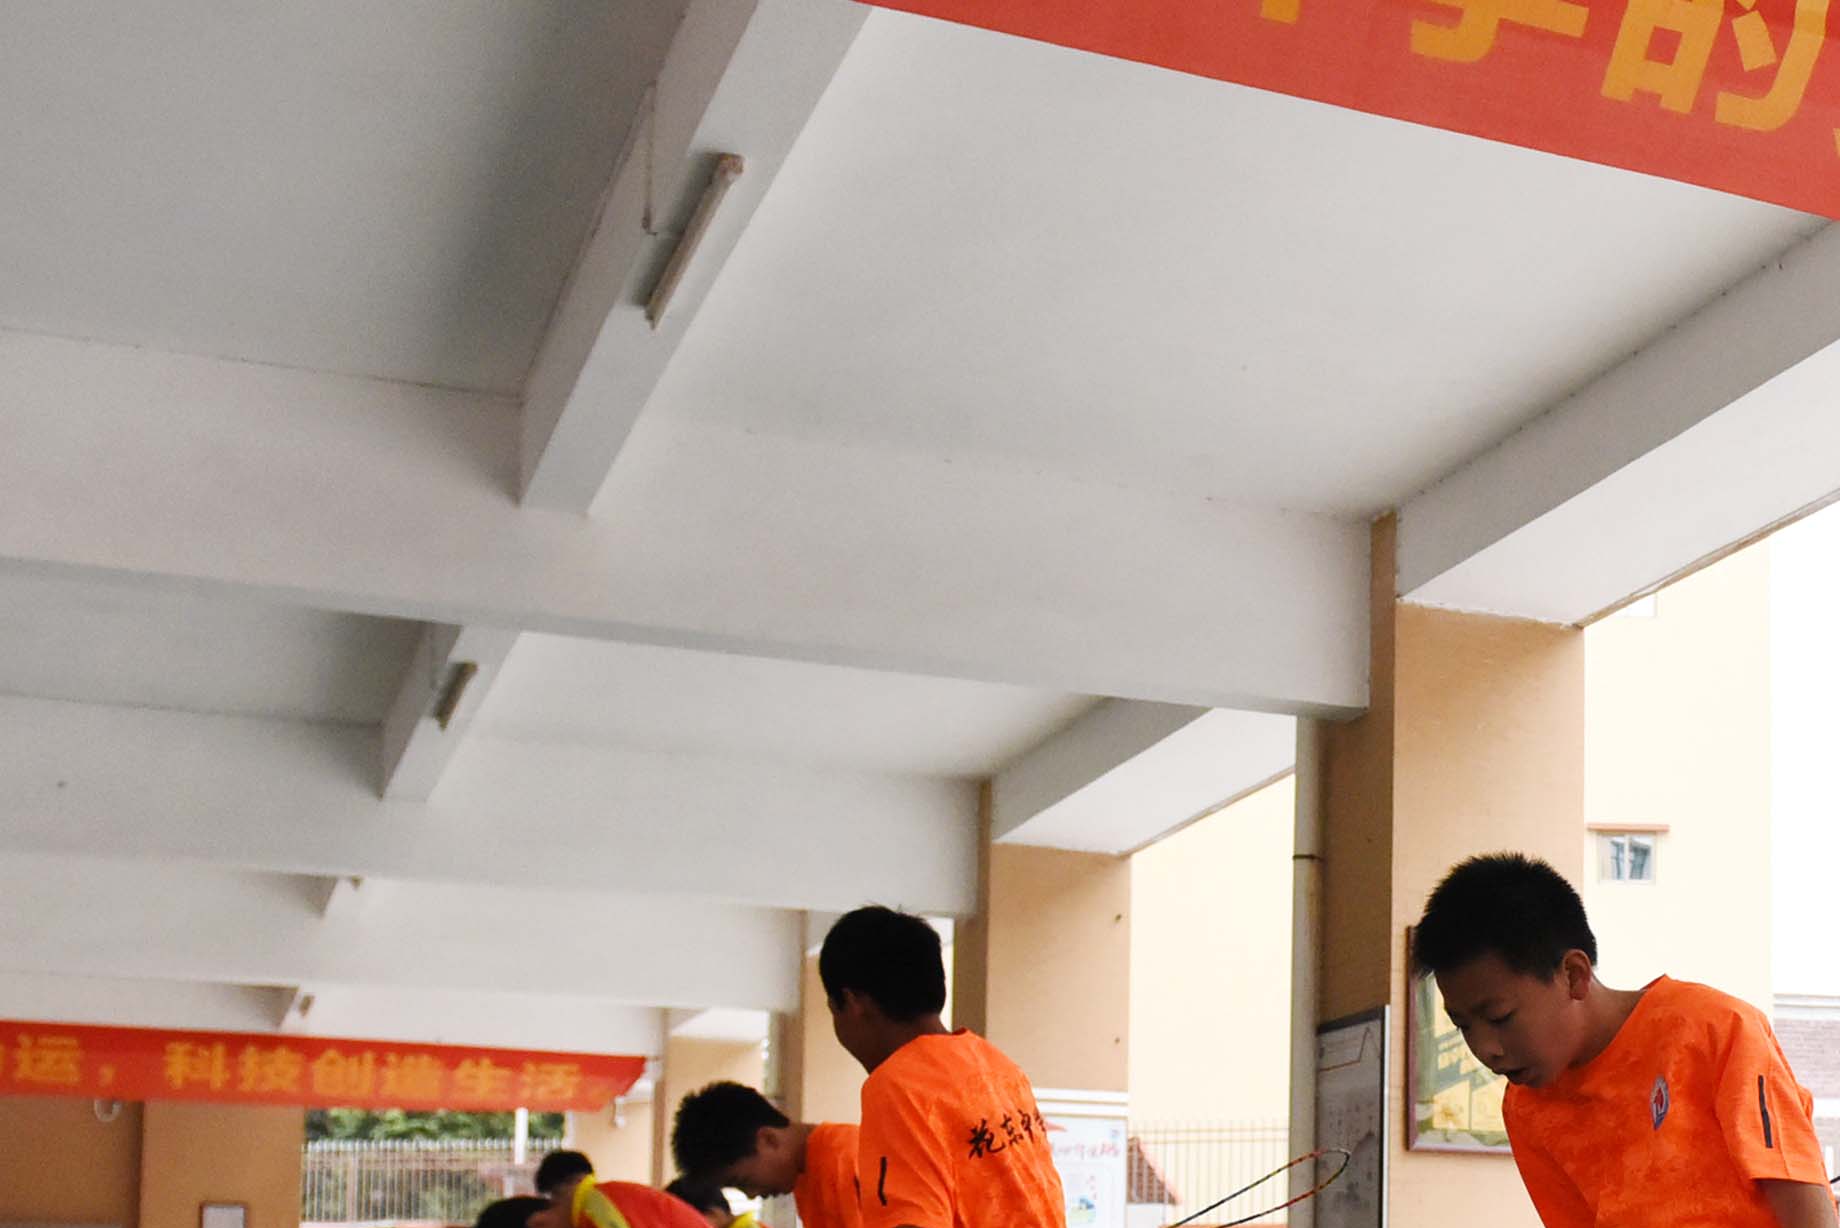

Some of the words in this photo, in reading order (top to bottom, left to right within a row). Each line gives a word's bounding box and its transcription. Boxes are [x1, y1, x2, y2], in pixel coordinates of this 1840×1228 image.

[0, 1032, 580, 1099] 运，科技创造生活
